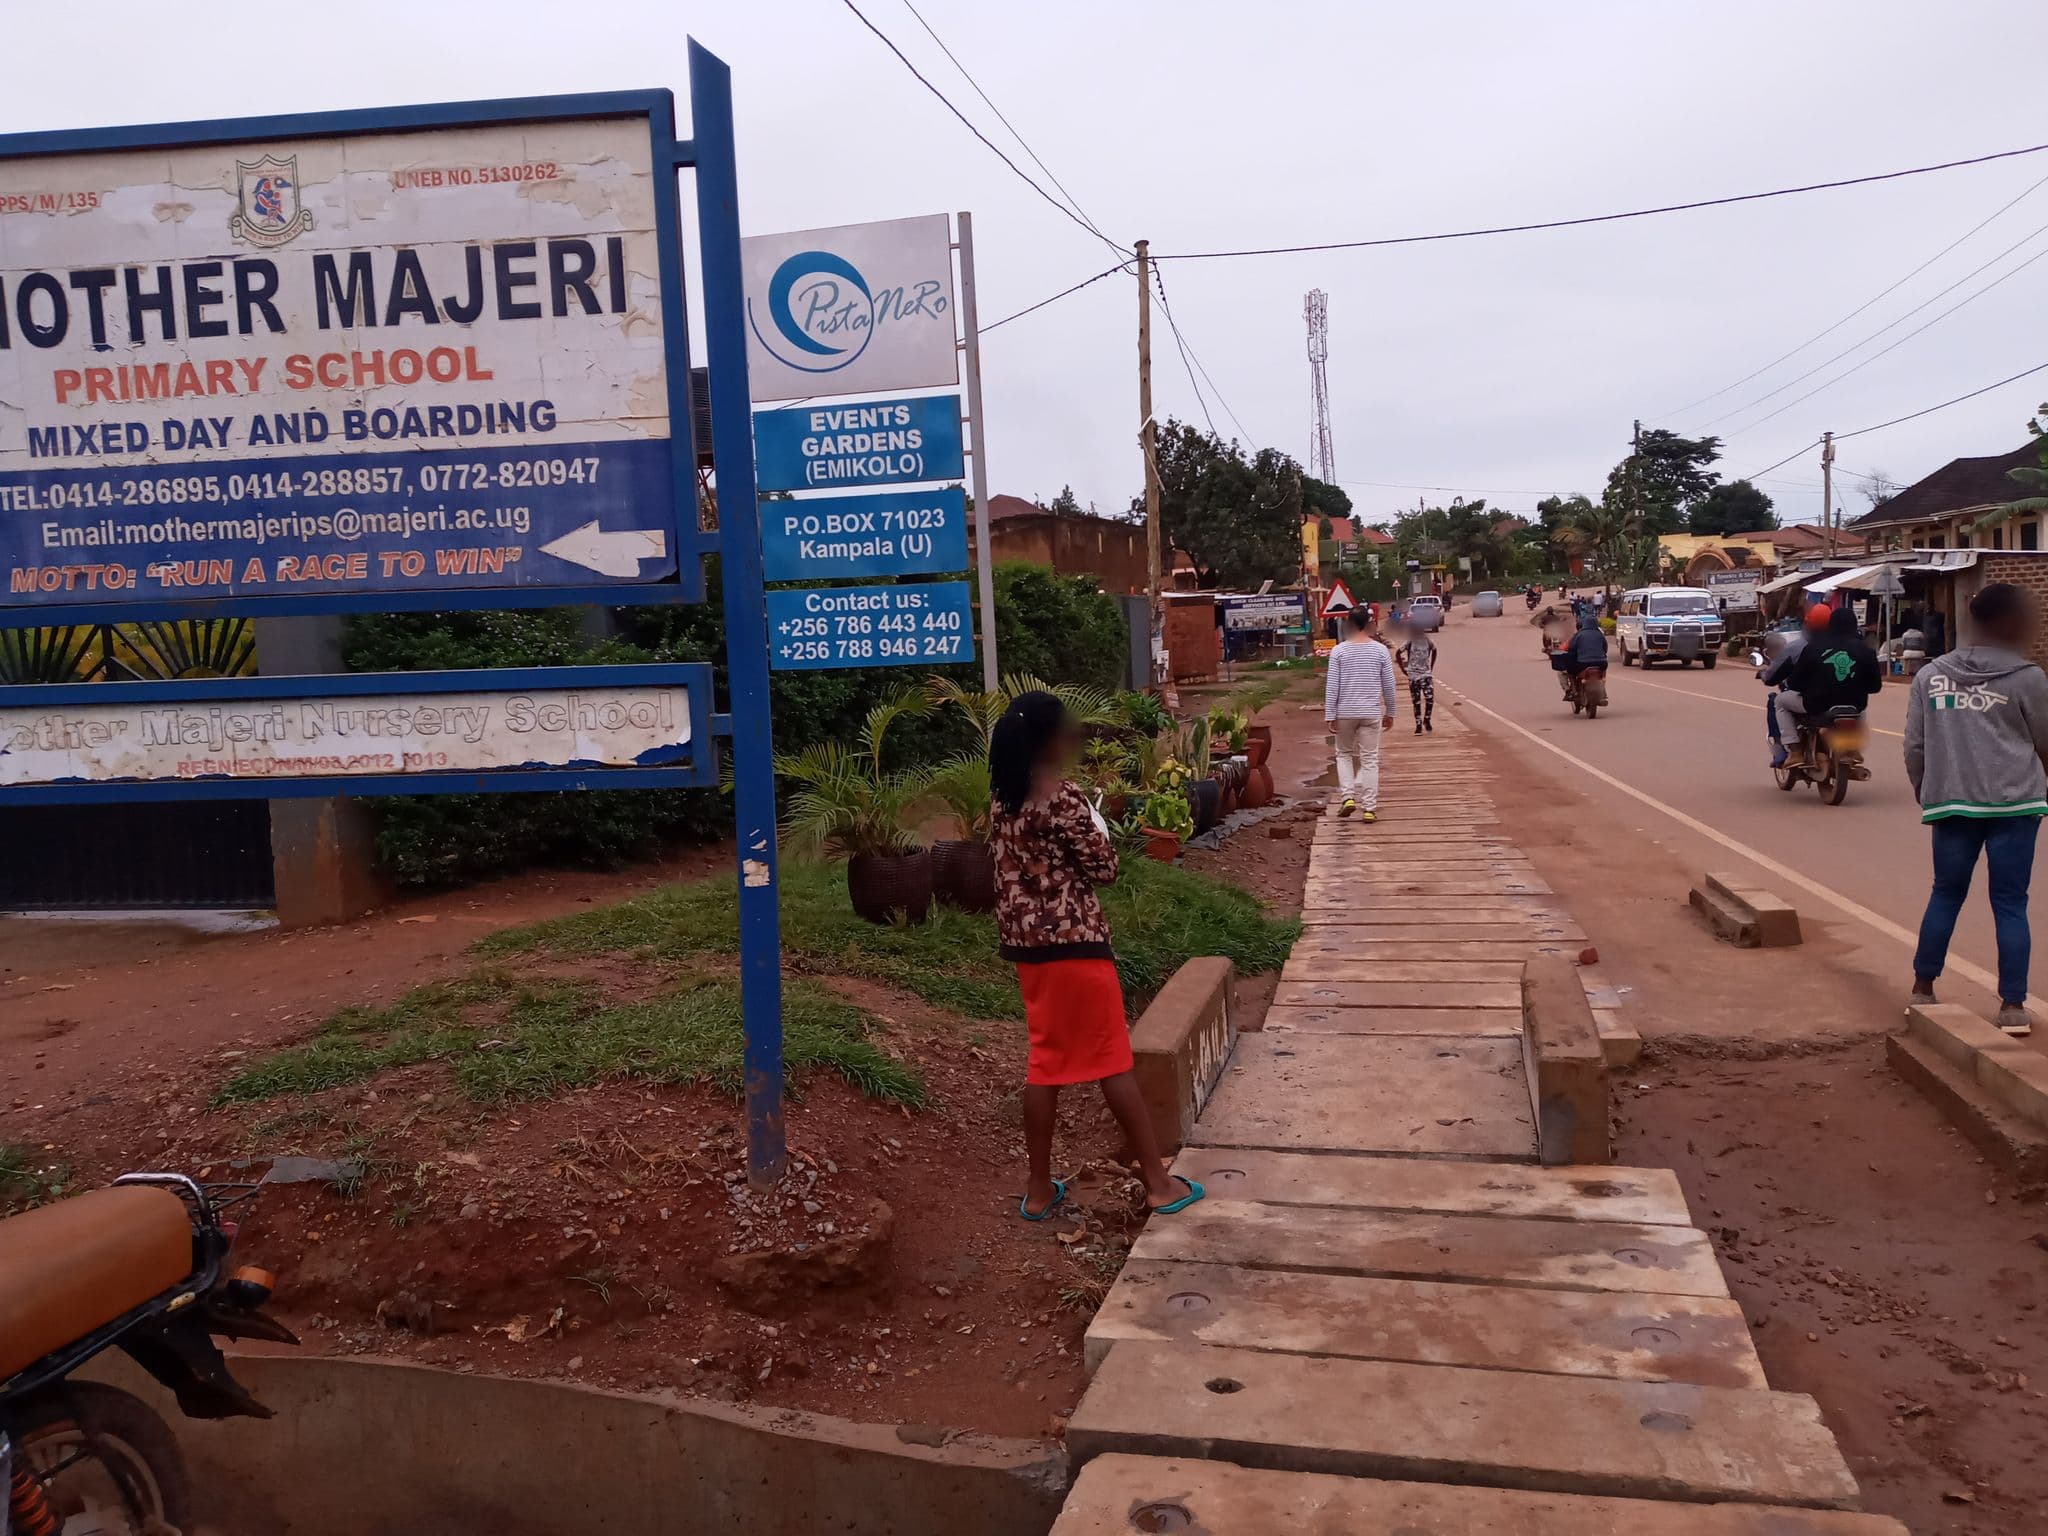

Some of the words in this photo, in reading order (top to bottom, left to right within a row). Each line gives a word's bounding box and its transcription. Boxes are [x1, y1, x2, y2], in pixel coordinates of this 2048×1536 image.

[394, 170, 443, 188] UNEB
[448, 163, 558, 185] NO.5130262
[312, 237, 627, 329] MAJERI
[798, 281, 870, 334] Pista
[54, 357, 267, 404] PRIMARY
[285, 346, 494, 389] SCHOOL
[28, 421, 148, 458] MIXED
[163, 416, 233, 452] DAY
[249, 411, 329, 446] AND
[343, 400, 557, 441] BOARDING
[810, 405, 910, 432] EVENTS
[801, 429, 922, 457] GARDENS
[420, 457, 600, 491] 0772-820947
[805, 453, 923, 484] (EMIKOLO)
[42, 504, 530, 548] Email:mothermajerips@majeri.ac.ug
[784, 513, 875, 536] P.O.BOX
[881, 508, 945, 531] 71023
[800, 537, 894, 561] Kampala
[900, 534, 932, 559] (U)
[10, 563, 136, 593] MOTTO:
[240, 557, 266, 583] A
[276, 553, 367, 581] RACE
[378, 550, 425, 578] TO
[805, 592, 889, 612] Contact
[896, 593, 929, 608] us:
[778, 618, 828, 637] +256
[834, 616, 872, 635] 786
[878, 614, 916, 633] 443
[922, 612, 960, 631] 440
[780, 642, 829, 660] +256
[836, 640, 873, 658] 788
[879, 637, 917, 656] 946
[924, 636, 961, 654] 247
[1954, 691, 2008, 712] BOY
[0, 715, 128, 751] other
[140, 705, 286, 751] Majeri
[301, 702, 490, 743] Nursery
[505, 692, 672, 733] School
